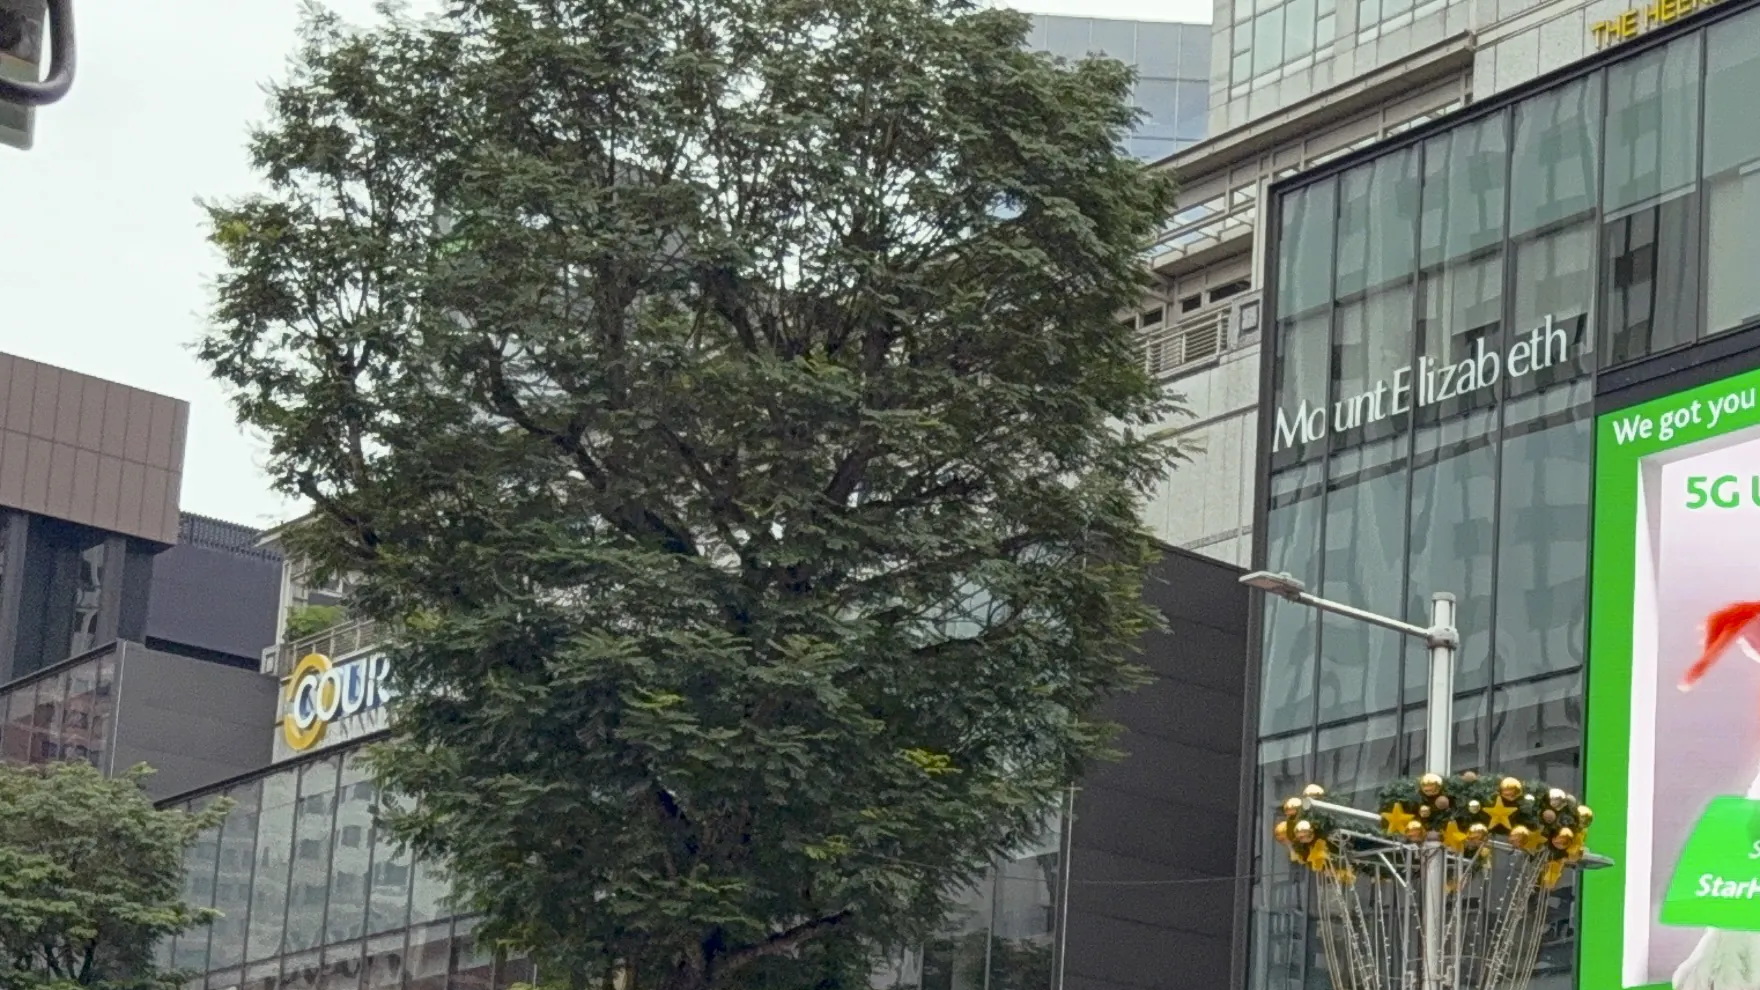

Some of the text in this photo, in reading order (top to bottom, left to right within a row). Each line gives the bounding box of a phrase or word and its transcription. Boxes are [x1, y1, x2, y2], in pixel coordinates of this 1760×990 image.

[1592, 0, 1718, 48] THE HEE
[1272, 315, 1567, 453] Mount Elizabeth
[1613, 387, 1756, 445] We got you
[1685, 474, 1740, 510] 5G
